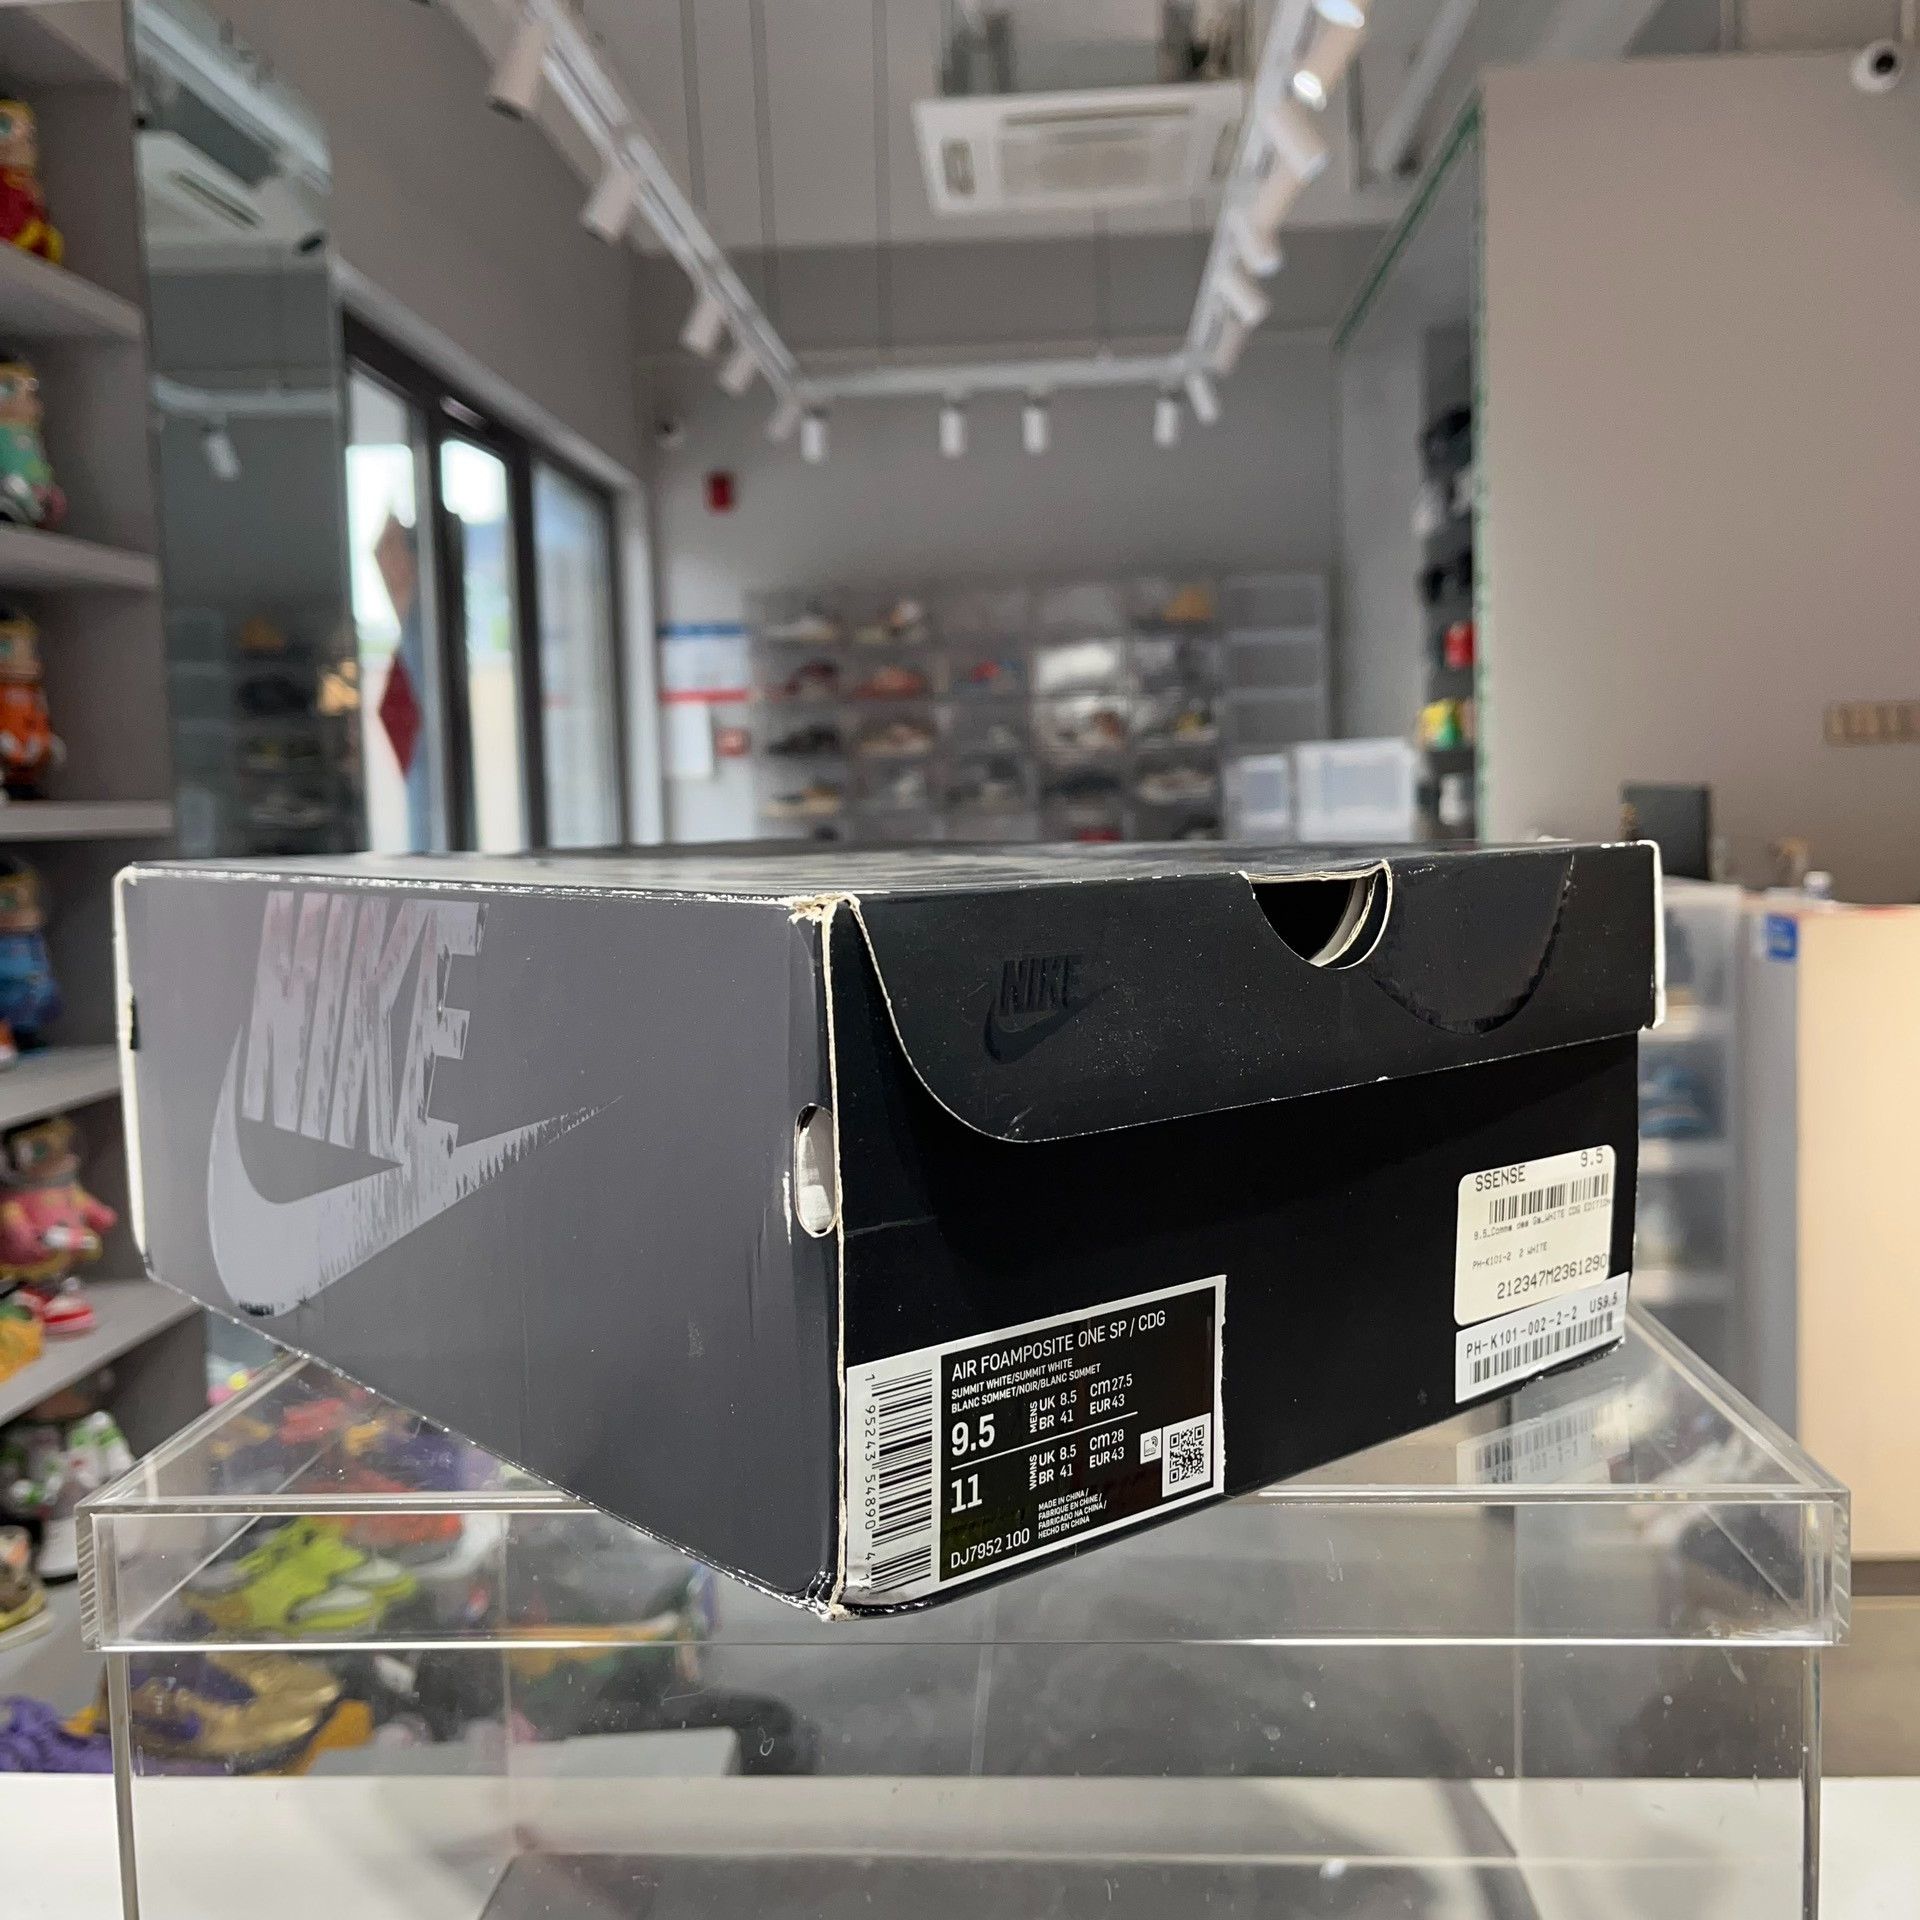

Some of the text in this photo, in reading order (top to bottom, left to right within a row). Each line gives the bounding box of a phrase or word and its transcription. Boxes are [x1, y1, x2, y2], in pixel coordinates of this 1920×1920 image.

[998, 951, 1083, 1016] NIKE
[242, 890, 489, 1161] NIKE
[1581, 1147, 1603, 1167] 9.5
[1475, 1165, 1526, 1192] SSENSE
[952, 1310, 1166, 1381] AIR FOAMPOSITE ONE SP / CDG
[1466, 1305, 1577, 1358] PH-K101-002-2-2
[952, 1358, 1073, 1400] SUMMIT WHITE/SUMMIT WHITE
[952, 1363, 1101, 1414] BLANC SOMMET/NOIR/BLANC SOMMET
[1039, 1390, 1077, 1411] UK 8.5
[952, 1413, 995, 1456] 9.5
[1039, 1409, 1073, 1430] BR 41
[1039, 1444, 1076, 1466] UK 8.5
[1029, 1454, 1037, 1490] WMNS
[1039, 1463, 1073, 1485] BR 41
[951, 1474, 982, 1513] 11
[1038, 1499, 1057, 1511] MADE
[1058, 1496, 1065, 1504] IN
[1066, 1490, 1084, 1502] CHINA
[1038, 1504, 1069, 1520] FABRIQUE
[1070, 1501, 1078, 1510] EN
[1080, 1494, 1098, 1506] CHINE
[1038, 1512, 1073, 1530] FABRICADO
[1074, 1509, 1083, 1518] NA
[1084, 1501, 1103, 1514] CHINA
[1038, 1515, 1090, 1539] HECHO EN CHINA
[951, 1528, 1030, 1568] DJ7952 100
